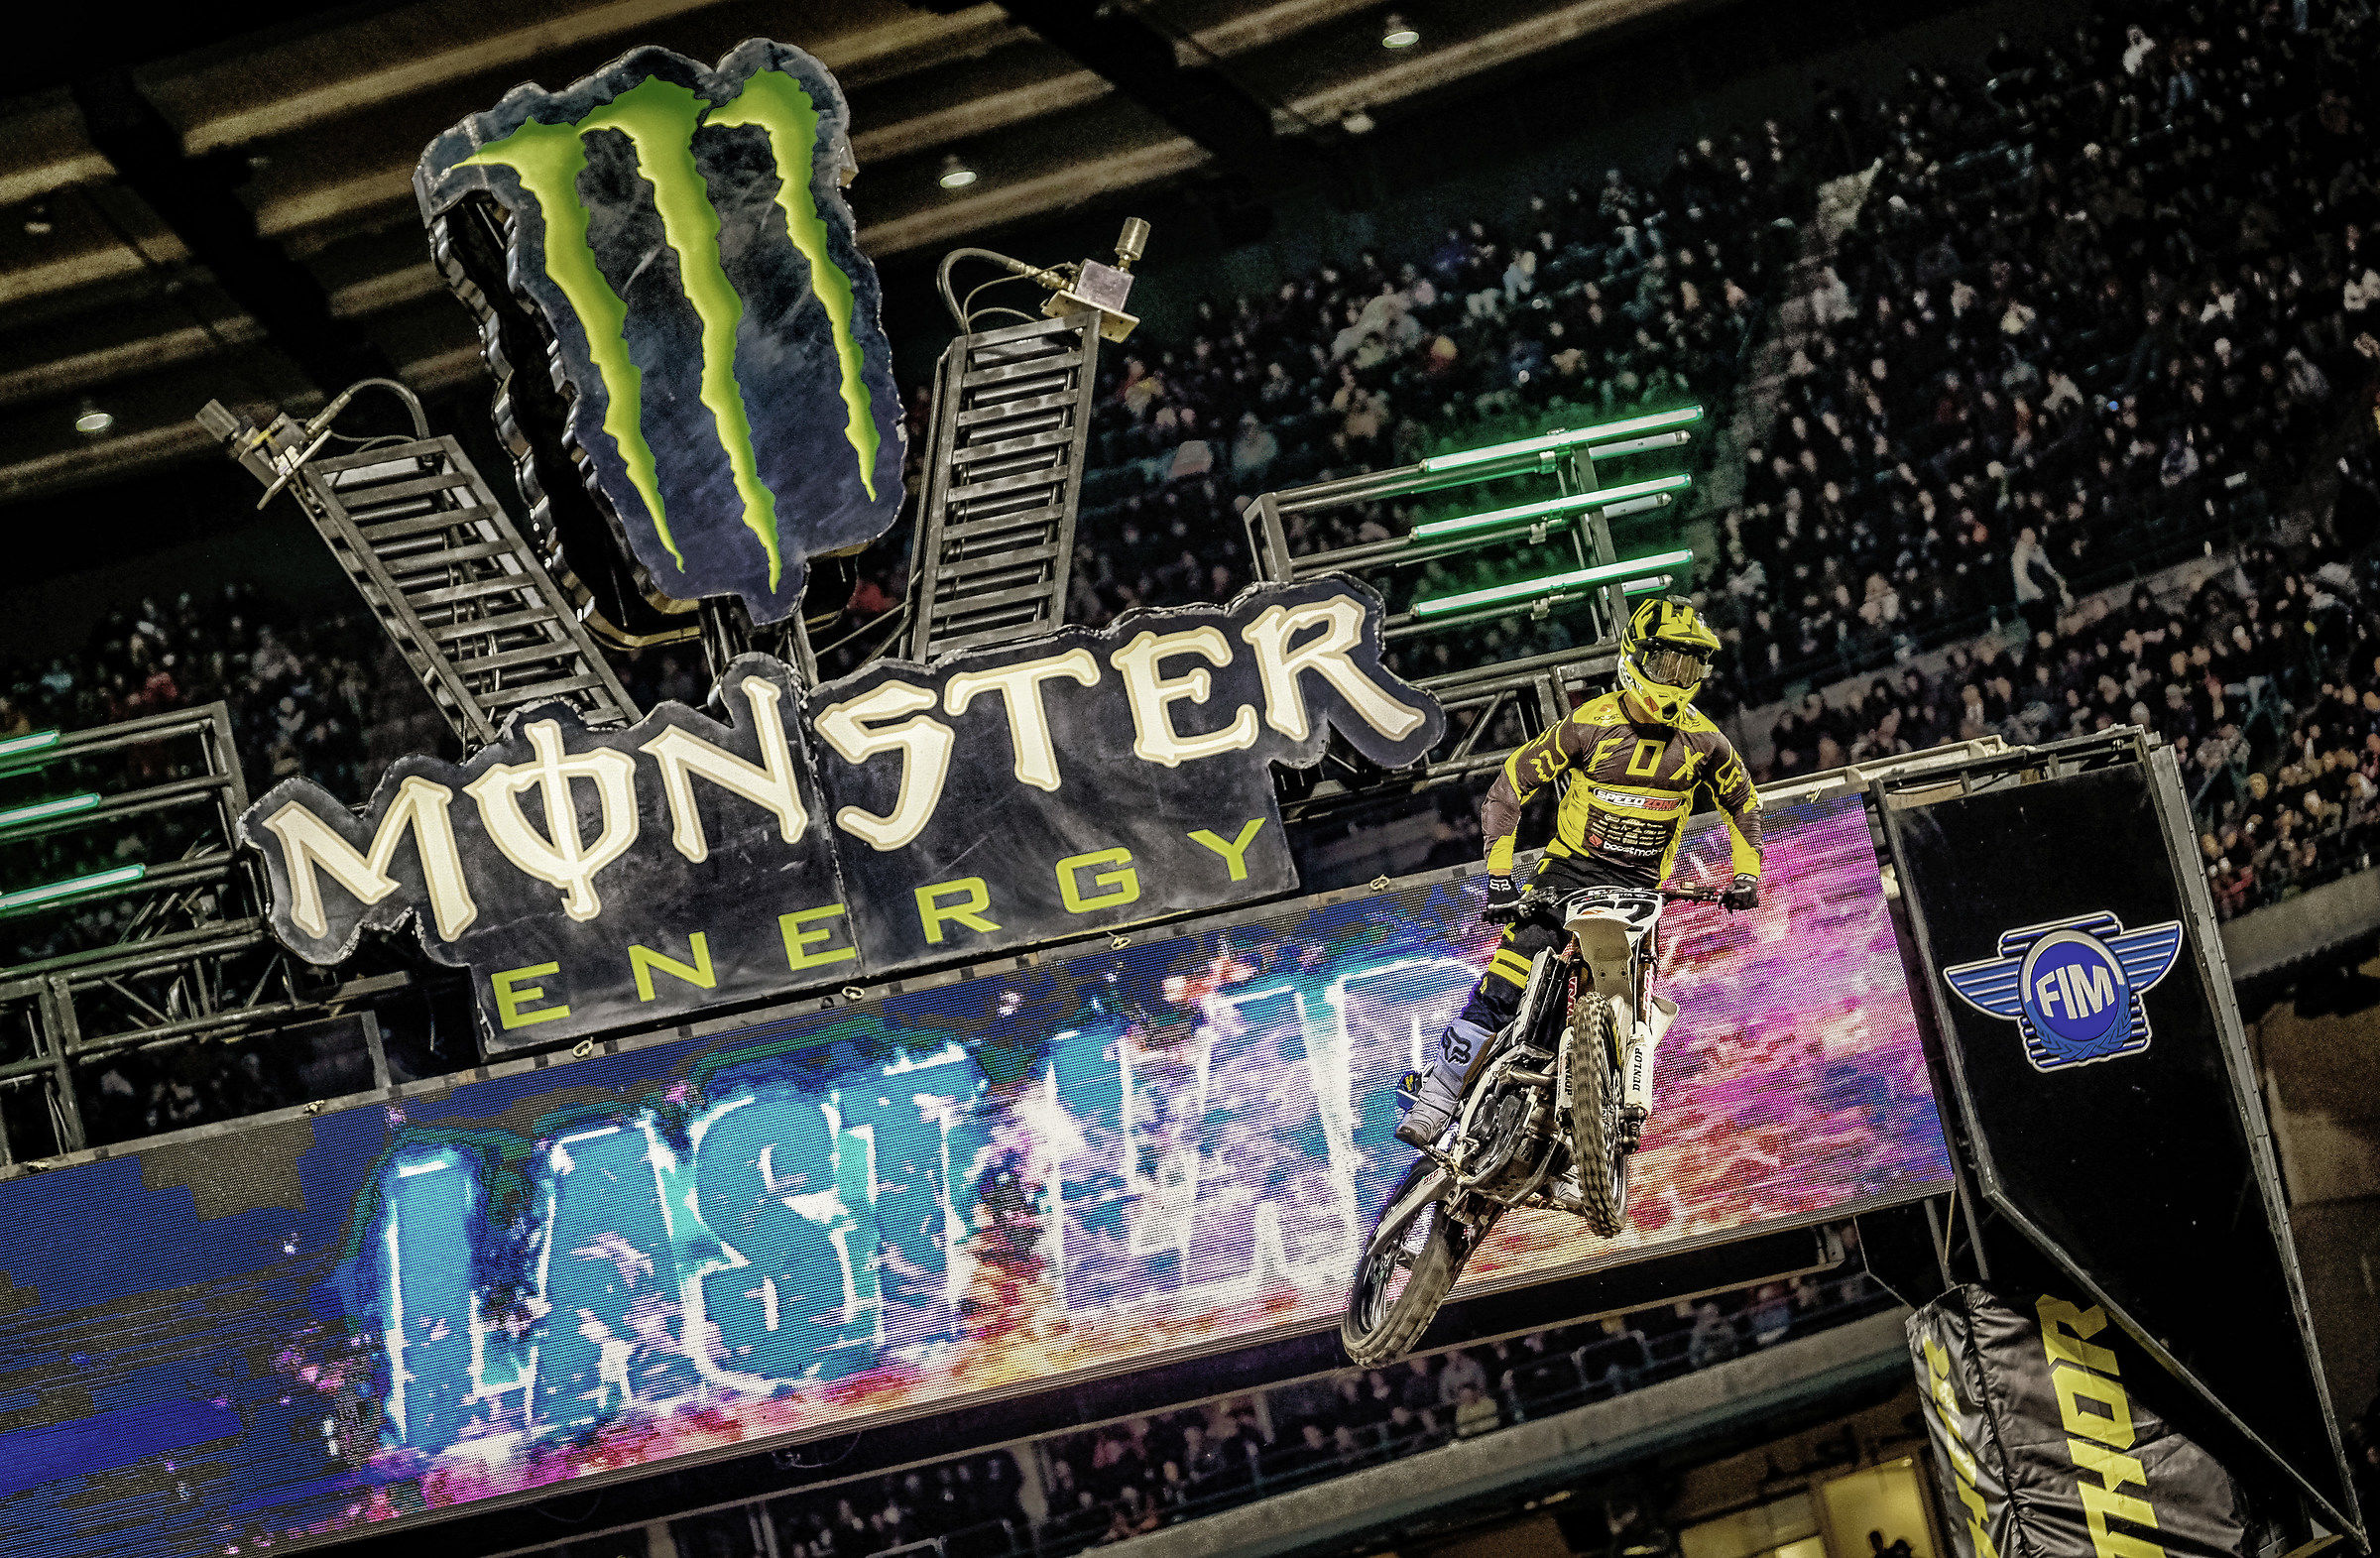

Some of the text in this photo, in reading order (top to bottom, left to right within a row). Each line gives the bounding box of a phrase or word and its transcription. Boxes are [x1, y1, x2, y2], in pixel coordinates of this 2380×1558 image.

[263, 593, 1425, 941] MONSTER
[1589, 737, 1705, 780] FOX
[491, 818, 1266, 1029] ENERGY
[2036, 964, 2115, 1019] FIM
[1631, 1047, 1644, 1092] DUNLOP
